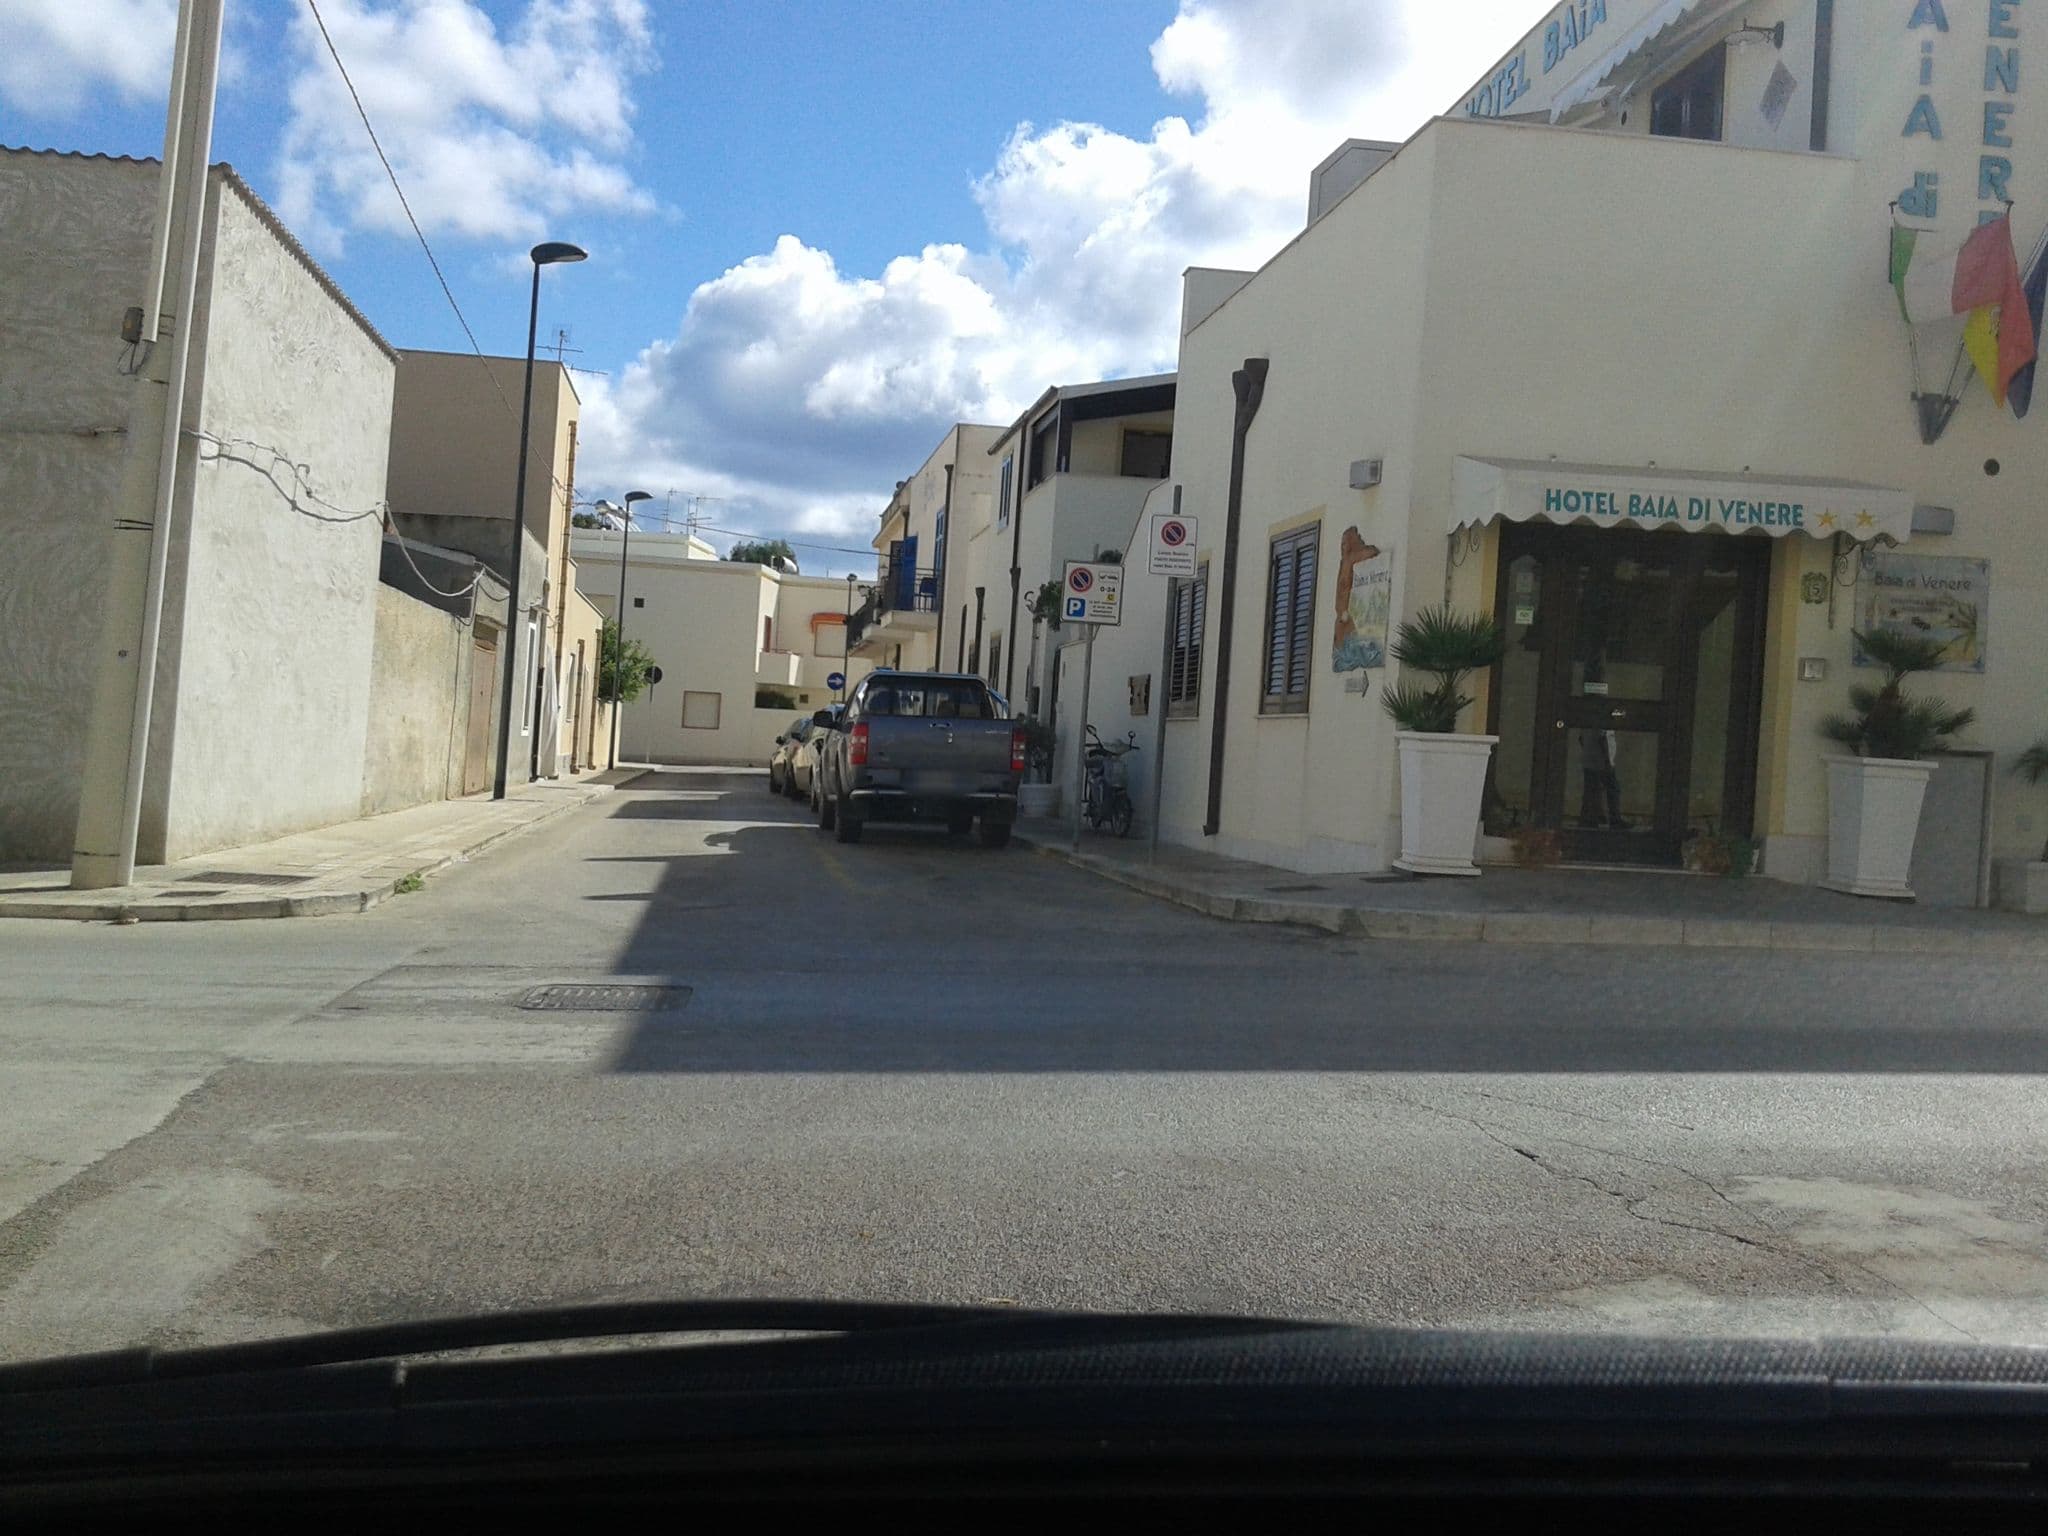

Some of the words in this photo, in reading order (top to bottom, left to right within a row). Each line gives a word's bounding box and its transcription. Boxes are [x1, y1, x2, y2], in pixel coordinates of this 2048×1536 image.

[1545, 488, 1620, 515] HOTEL
[1628, 493, 1680, 519] BAIA
[1687, 497, 1711, 521] DI
[1718, 499, 1804, 527] VENERE
[1921, 573, 1972, 591] Venere
